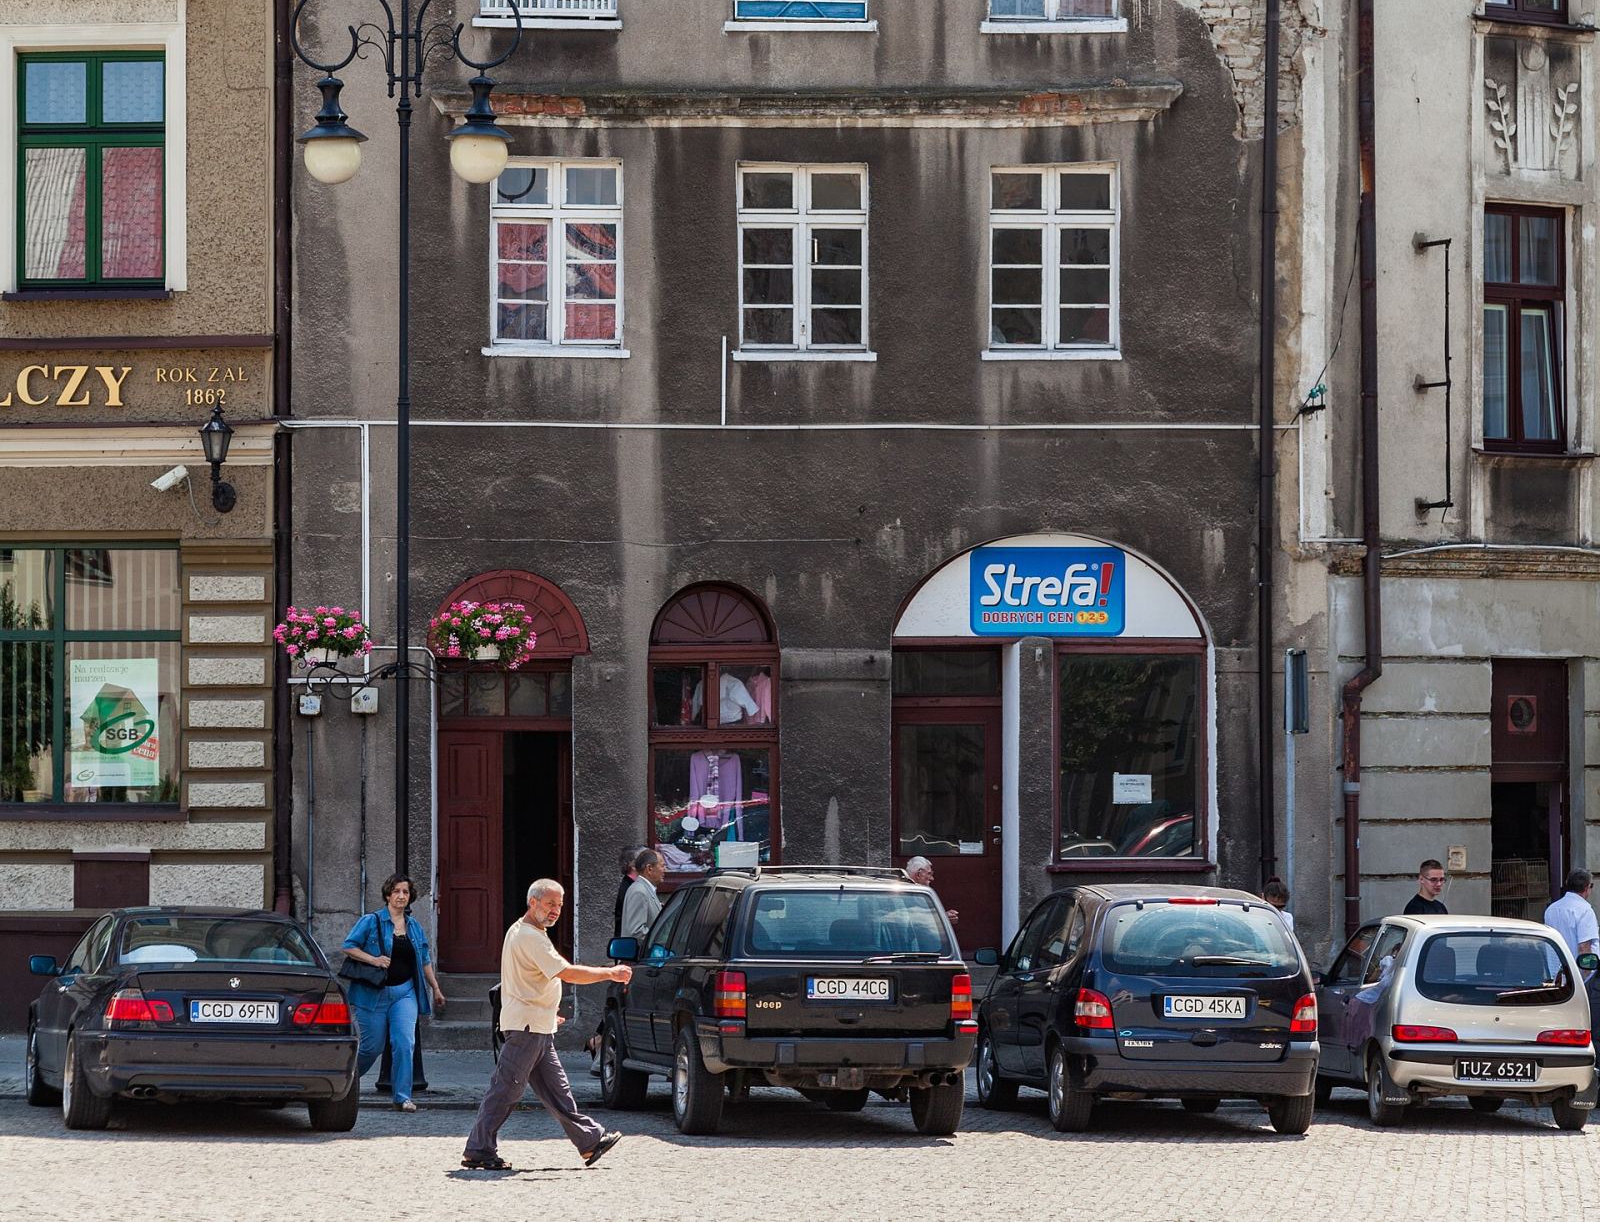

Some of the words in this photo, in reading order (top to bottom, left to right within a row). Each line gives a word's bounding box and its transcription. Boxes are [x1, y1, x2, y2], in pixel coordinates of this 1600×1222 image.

[156, 367, 198, 383] ROK
[186, 388, 226, 405] 1862
[983, 612, 1043, 623] DOBRYCH
[1048, 612, 1073, 623] CEN
[106, 728, 138, 740] SGB
[816, 980, 848, 994] CGD
[852, 981, 888, 995] 44CG
[201, 1003, 234, 1018] CGD
[238, 1004, 275, 1019] 69FN
[755, 1000, 782, 1010] Jeep
[1173, 999, 1205, 1013] CGD
[1208, 999, 1243, 1014] 45KA
[1460, 1061, 1492, 1076] TUZ
[1497, 1062, 1532, 1077] 6521
